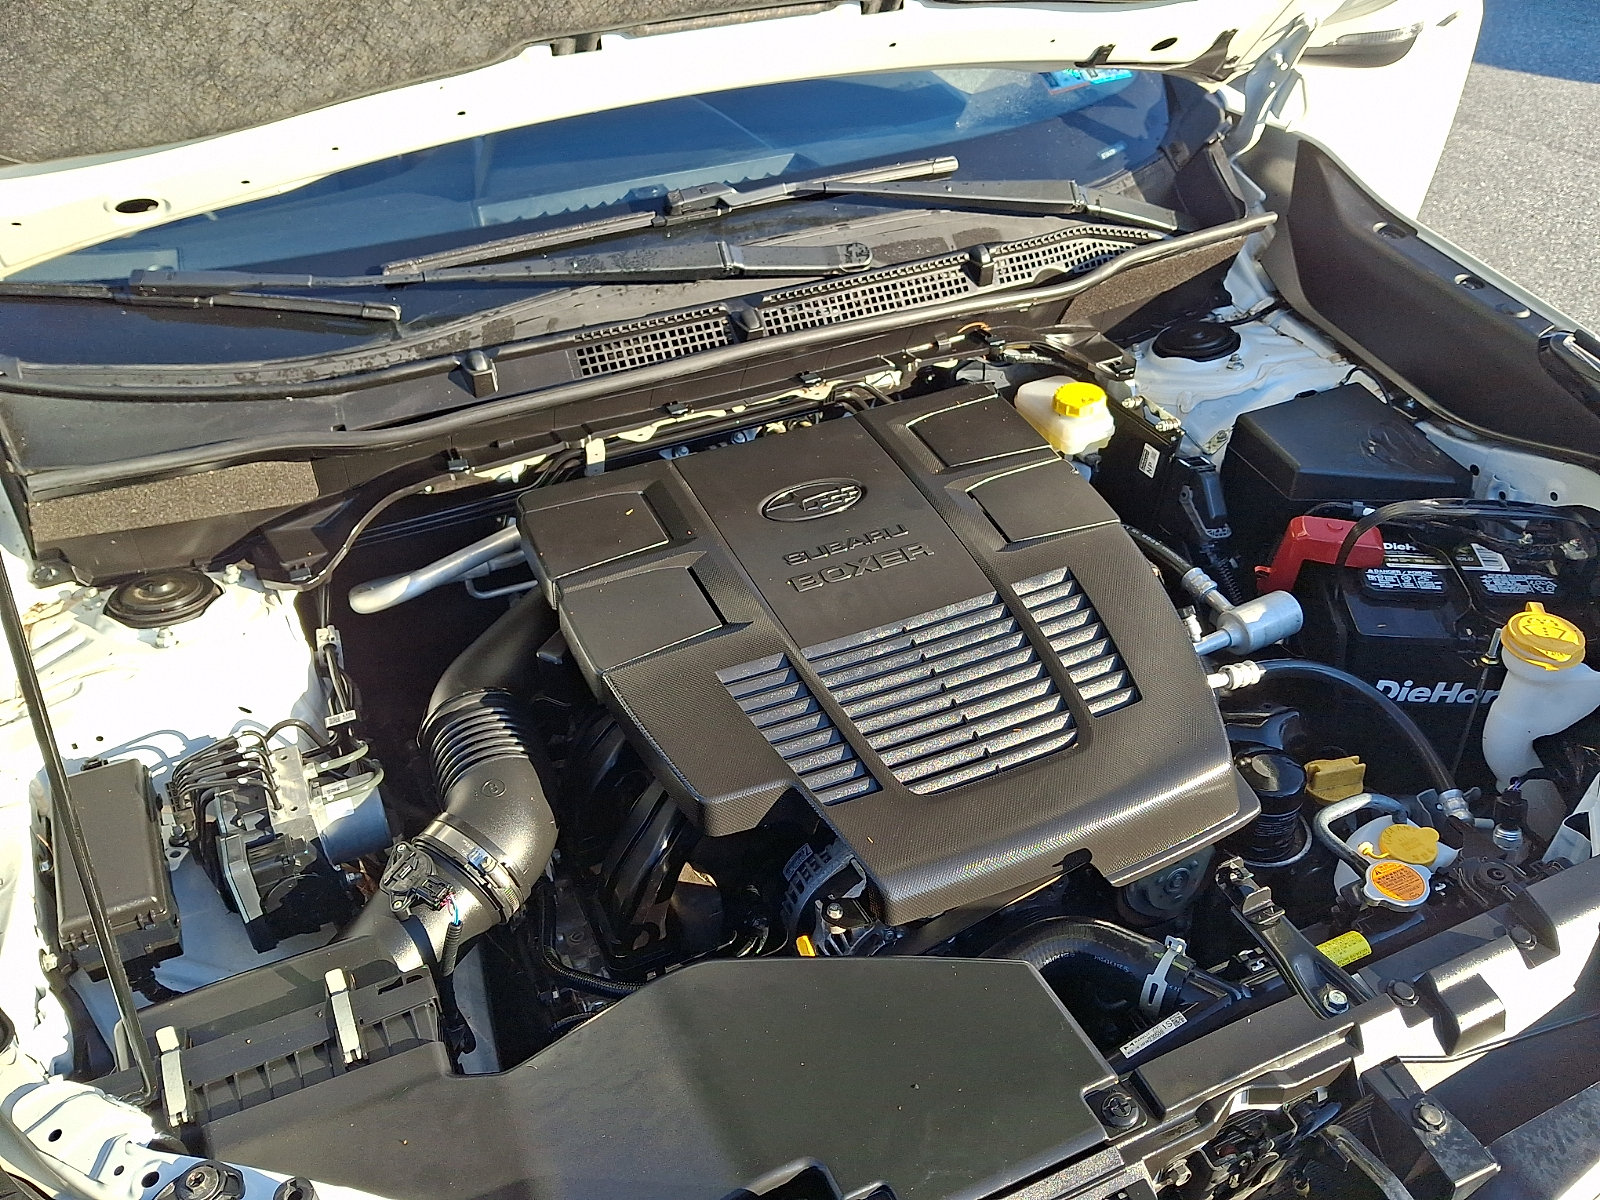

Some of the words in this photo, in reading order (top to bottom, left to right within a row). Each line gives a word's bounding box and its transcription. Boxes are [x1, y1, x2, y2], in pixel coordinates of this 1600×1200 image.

[783, 524, 909, 566] SUBARU
[790, 542, 935, 593] BOXER
[1376, 679, 1501, 704] DieHar
